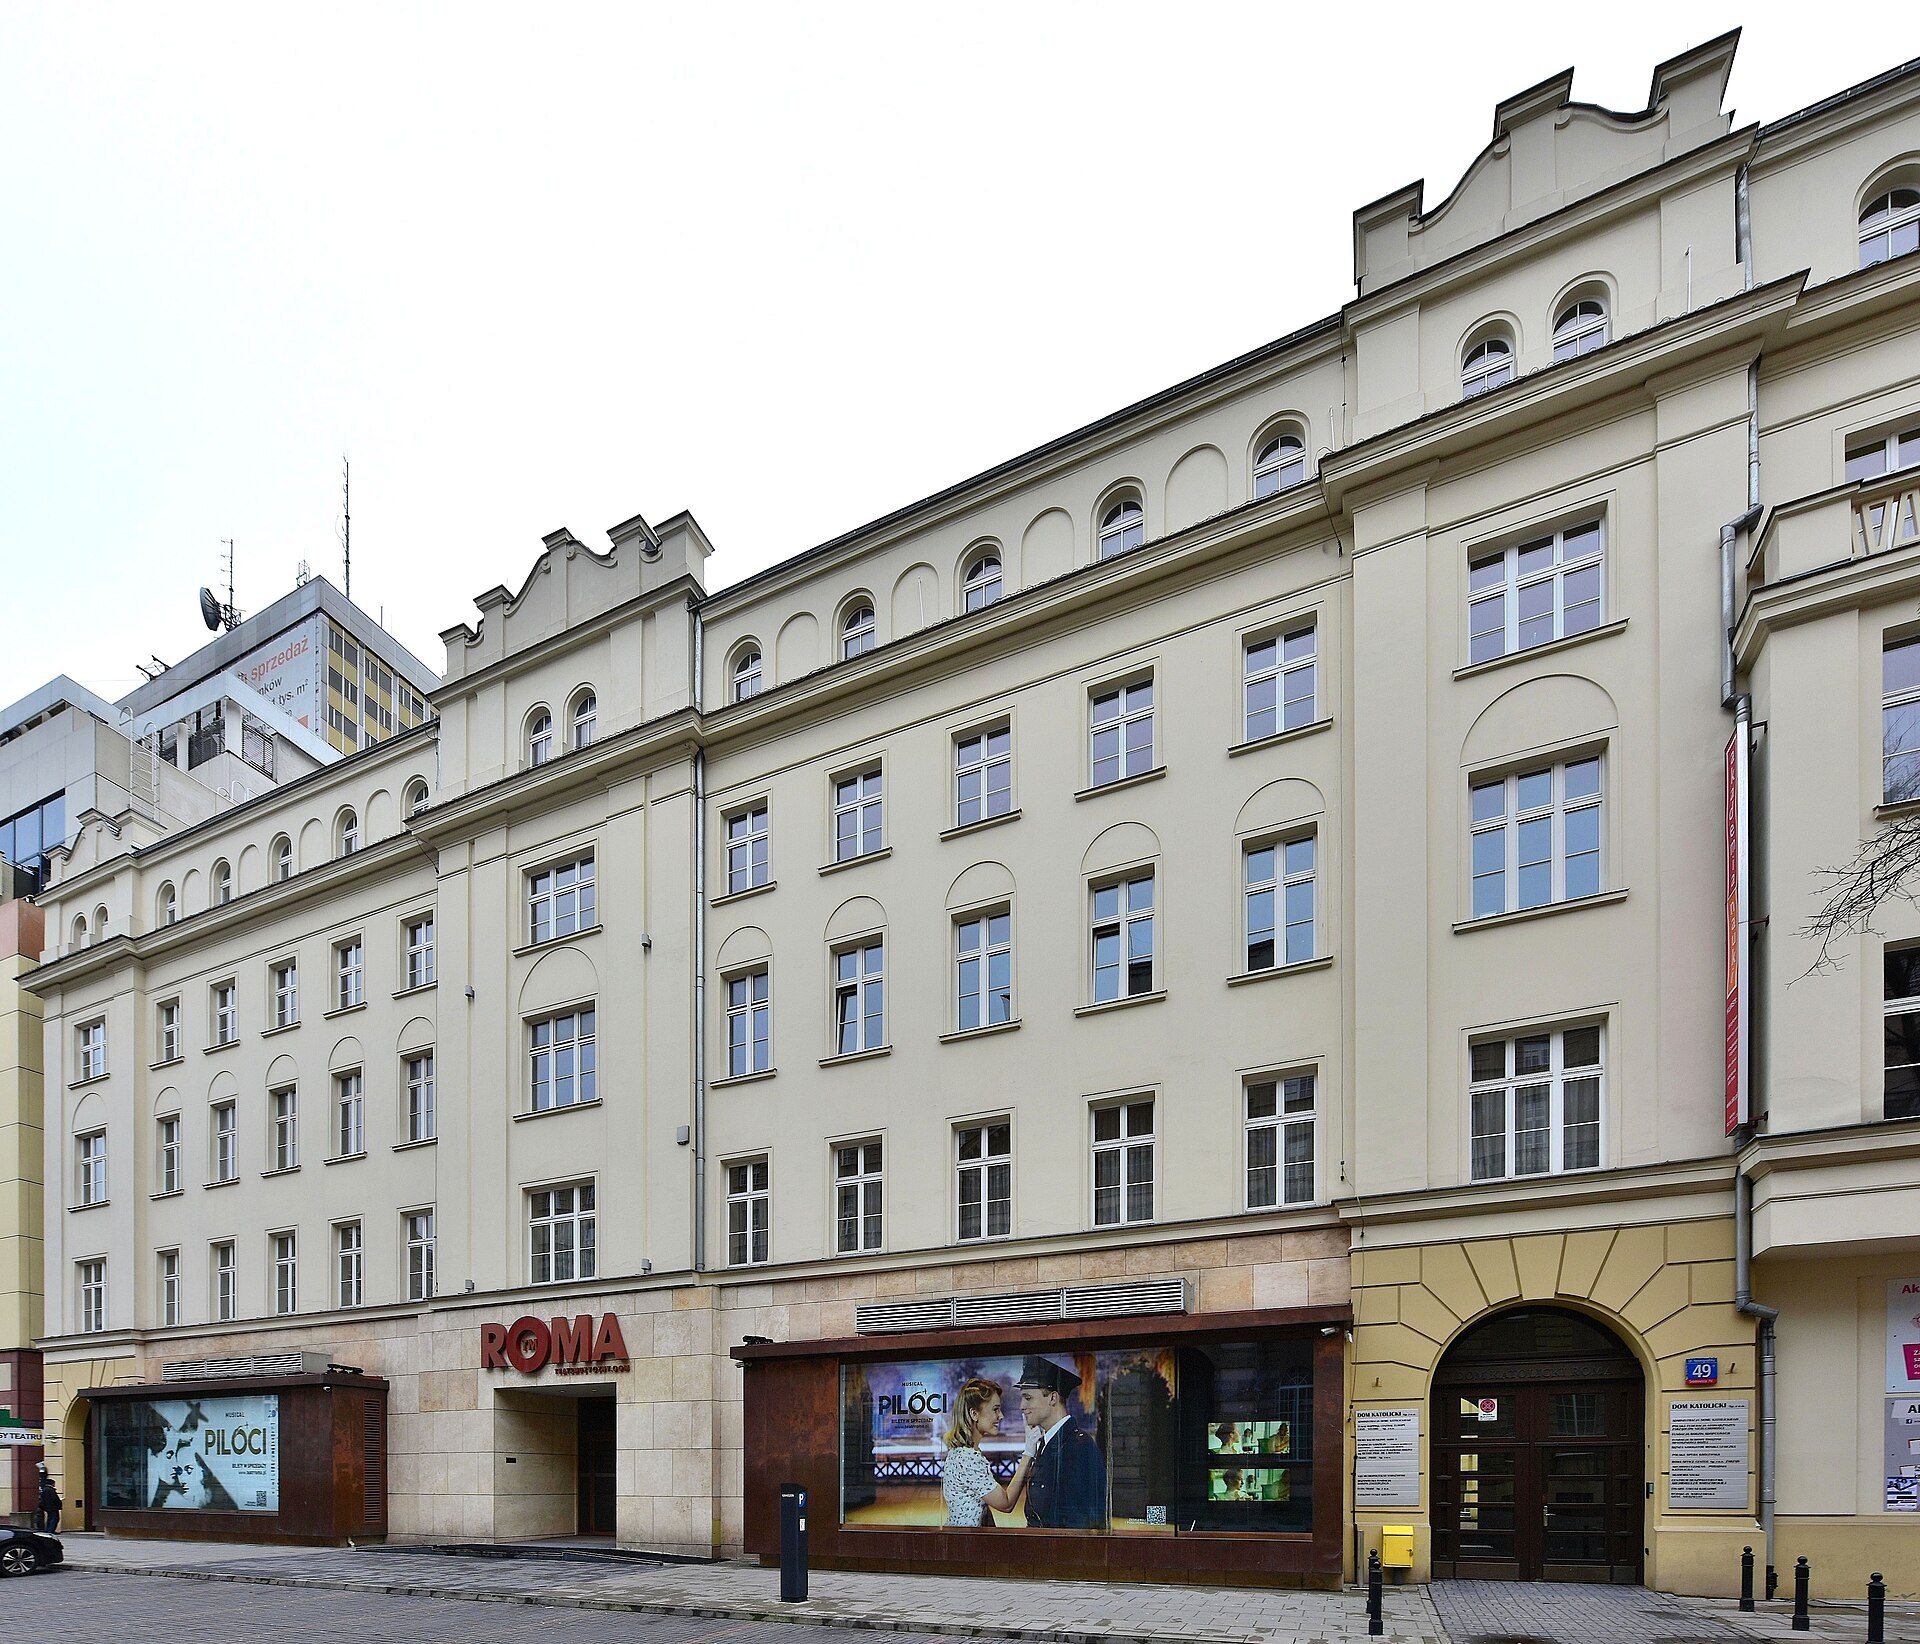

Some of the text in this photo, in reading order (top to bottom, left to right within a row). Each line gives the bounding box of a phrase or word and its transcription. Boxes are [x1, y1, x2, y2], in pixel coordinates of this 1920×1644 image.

[251, 634, 309, 682] sprzedaż
[279, 691, 295, 706] tys.
[480, 1312, 630, 1374] ROMA
[1692, 1363, 1712, 1378] 49
[10, 1432, 43, 1440] TEATRU
[798, 1493, 804, 1505] P
